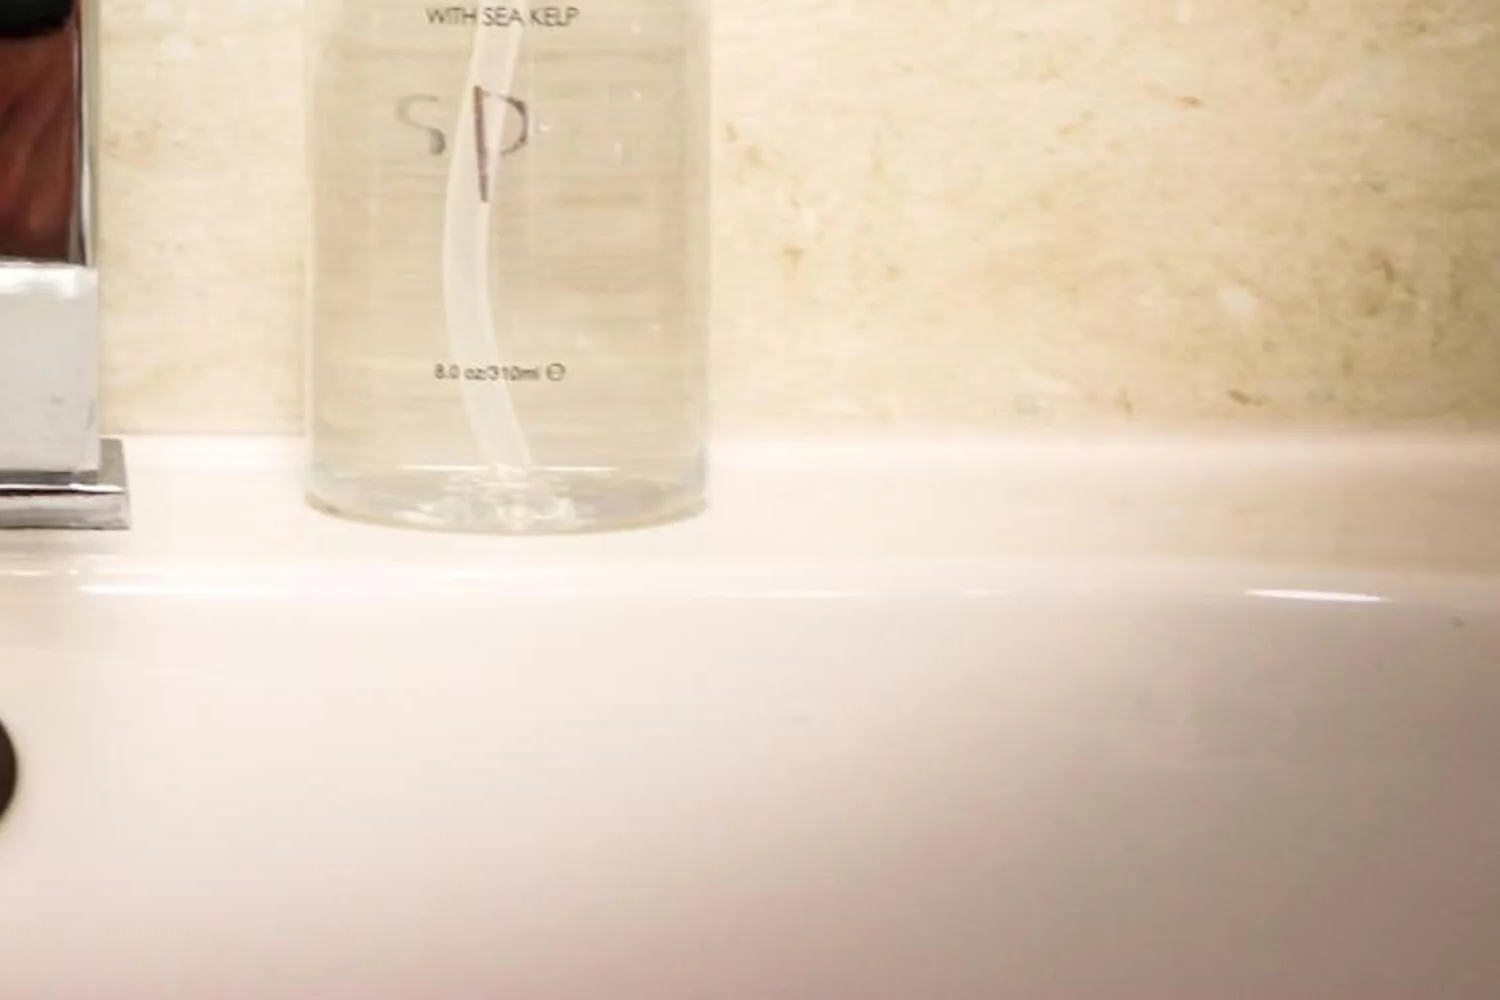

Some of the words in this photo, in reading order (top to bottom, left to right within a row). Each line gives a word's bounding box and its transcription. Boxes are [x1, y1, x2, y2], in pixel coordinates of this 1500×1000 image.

[425, 5, 478, 25] WITH
[482, 5, 525, 28] SEA
[529, 5, 580, 27] KELP
